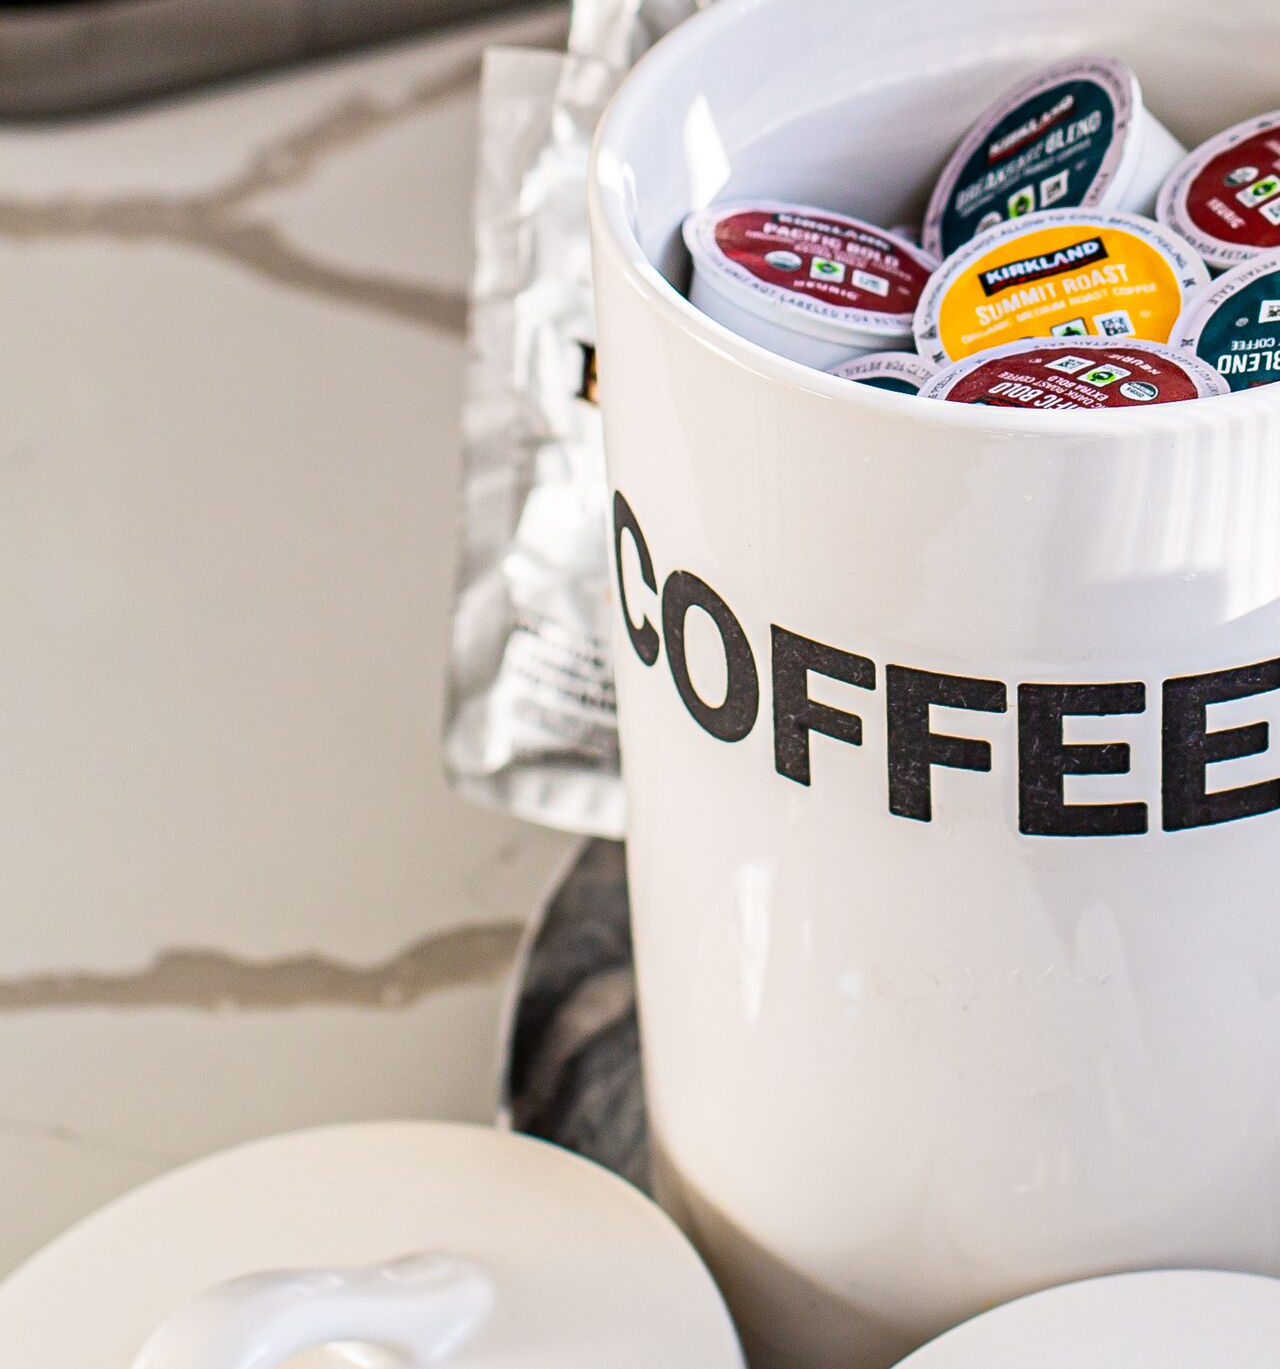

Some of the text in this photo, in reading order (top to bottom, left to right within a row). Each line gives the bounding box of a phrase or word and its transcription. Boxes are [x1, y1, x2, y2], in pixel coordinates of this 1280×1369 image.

[1045, 110, 1102, 154] BLEND
[762, 222, 842, 249] PACIFIC
[846, 242, 900, 268] BOLD
[985, 240, 1100, 285] KIRKLAND
[975, 282, 1058, 326] SUMMIT
[1062, 263, 1129, 296] ROAST
[1068, 288, 1109, 307] ROAST
[1231, 338, 1276, 352] COFFEE
[988, 382, 1043, 402] BOLD
[997, 371, 1094, 405] DARK ROAST COFFEE
[1047, 375, 1109, 402] EXTRA BOLD
